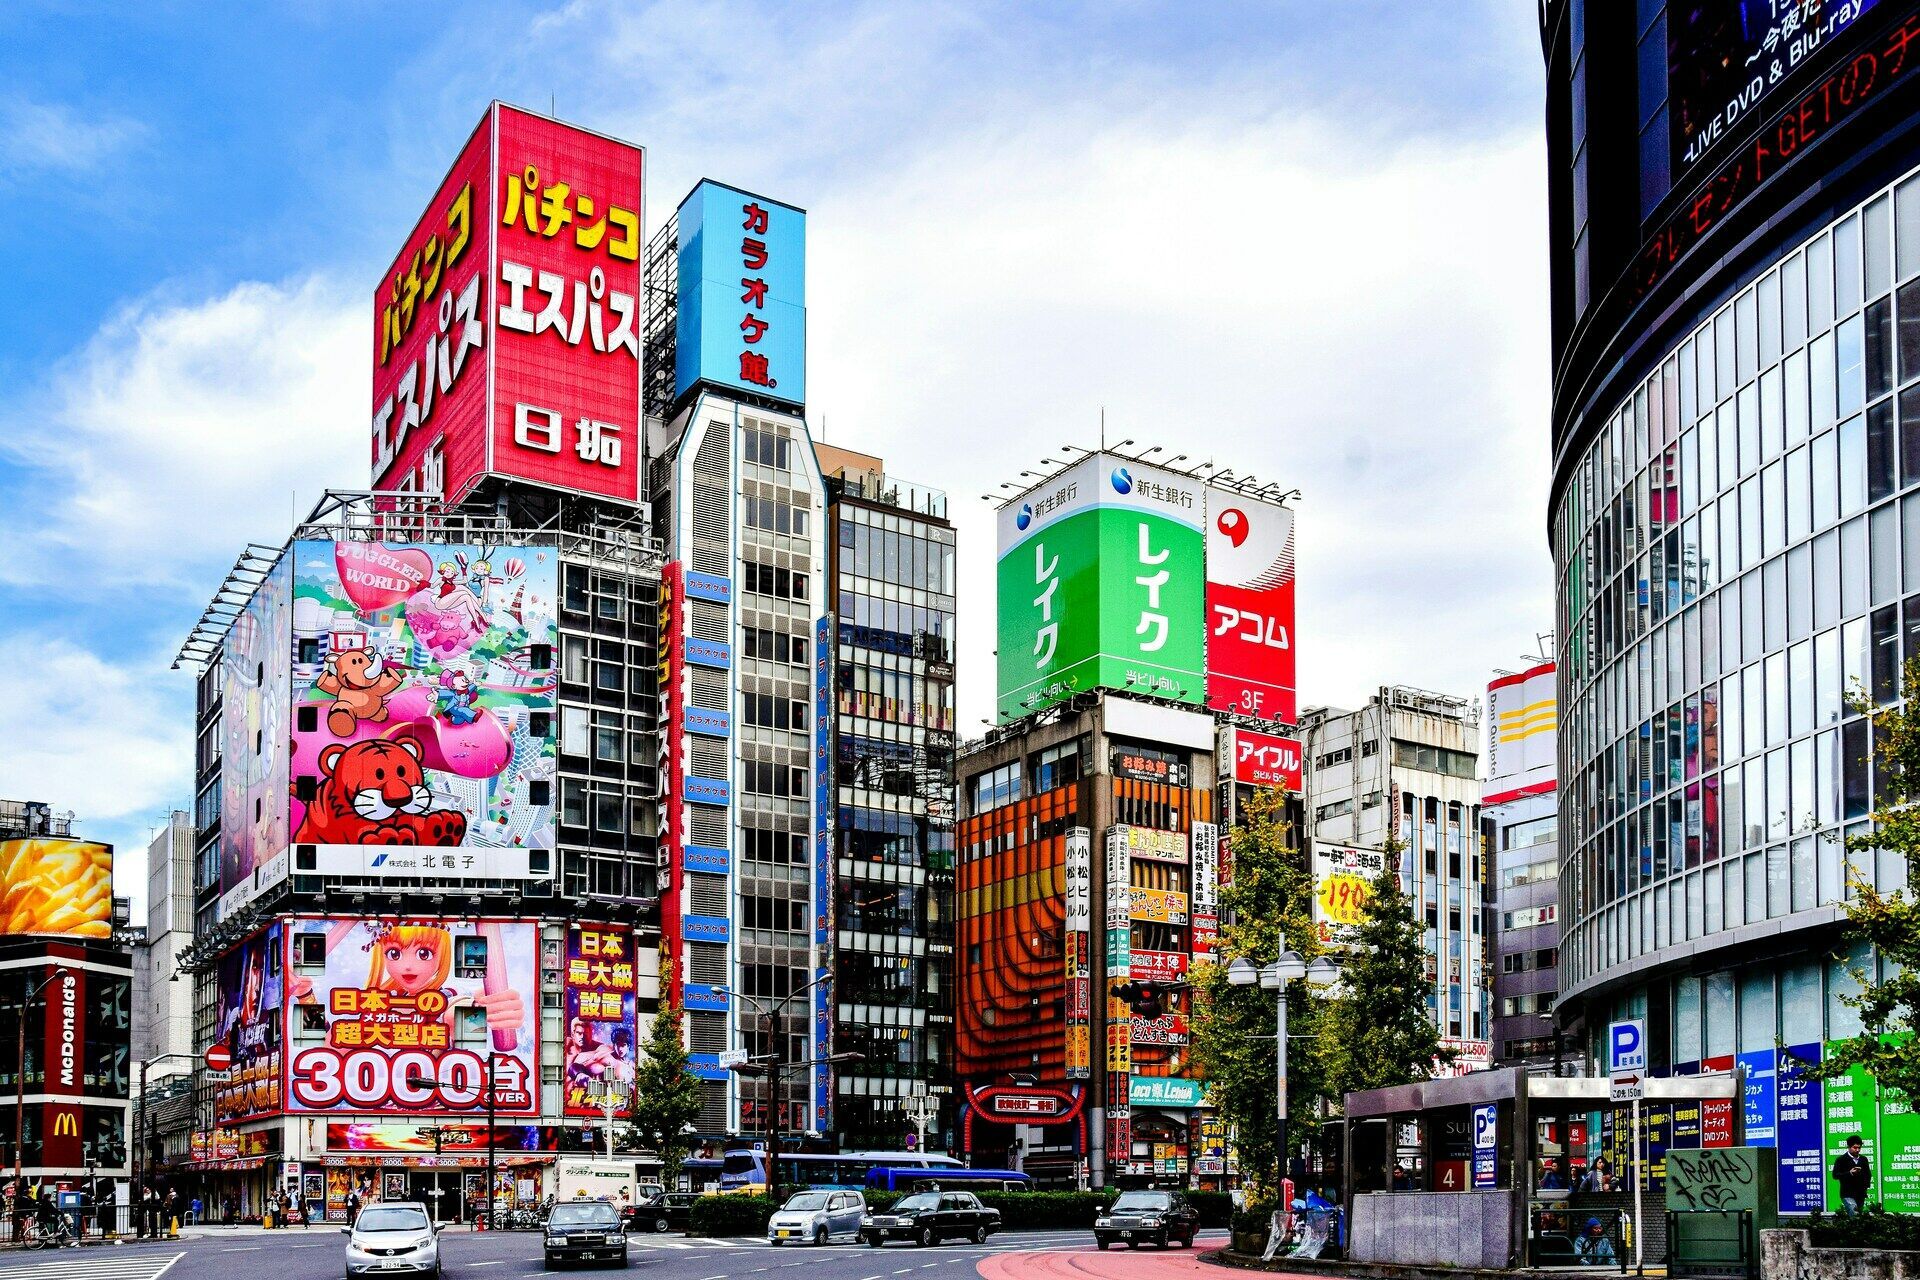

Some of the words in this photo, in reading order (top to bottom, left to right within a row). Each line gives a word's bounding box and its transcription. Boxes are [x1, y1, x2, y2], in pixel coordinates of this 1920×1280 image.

[1726, 77, 1764, 124] DVD
[1769, 59, 1784, 85] &
[1789, 0, 1863, 67] Blu-ray
[502, 163, 639, 262] パチンコ
[380, 180, 471, 368] パチンコ
[499, 260, 639, 360] エスパス
[371, 271, 483, 487] エスパス
[1034, 481, 1079, 519] 新生銀行
[1136, 479, 1194, 509] 新生銀行
[346, 567, 411, 593] WORLD
[1135, 522, 1171, 652] レイク
[1033, 543, 1060, 670] レイク
[658, 576, 672, 685] パチンコ
[1214, 604, 1290, 650] アコム
[1241, 689, 1264, 710] 3F
[657, 690, 671, 838] エスパス
[1238, 740, 1300, 771] アイフル
[389, 859, 417, 868] 株式会社
[422, 854, 475, 869] 北電子
[1077, 845, 1089, 918] 小松ビル
[1164, 894, 1185, 910] 焼き
[581, 931, 623, 958] 日本
[568, 960, 634, 988] 最大級
[333, 990, 445, 1013] 日本一の
[580, 992, 622, 1018] 設置
[363, 1012, 425, 1023] メガホール
[1130, 1016, 1174, 1029] ゃぶしゃぶ
[60, 975, 76, 1087] McDonald's
[335, 1022, 446, 1047] 超大型店
[1130, 1028, 1168, 1042] どんすき
[1612, 1024, 1640, 1068] P
[1627, 1088, 1642, 1098] 150m
[1745, 1083, 1763, 1096] ジカメ
[1780, 1079, 1808, 1091] エアコン
[1828, 1076, 1854, 1088] 冷蔵庫
[1780, 1093, 1808, 1107] 季節家電
[1828, 1091, 1854, 1103] 洗濯機
[1703, 1117, 1726, 1128] オーディオ
[1780, 1108, 1808, 1122] 調理家電
[1828, 1106, 1854, 1119] 掃除機
[1476, 1114, 1488, 1145] P
[1828, 1121, 1863, 1134] 照明器具
[1442, 1168, 1455, 1188] 4
